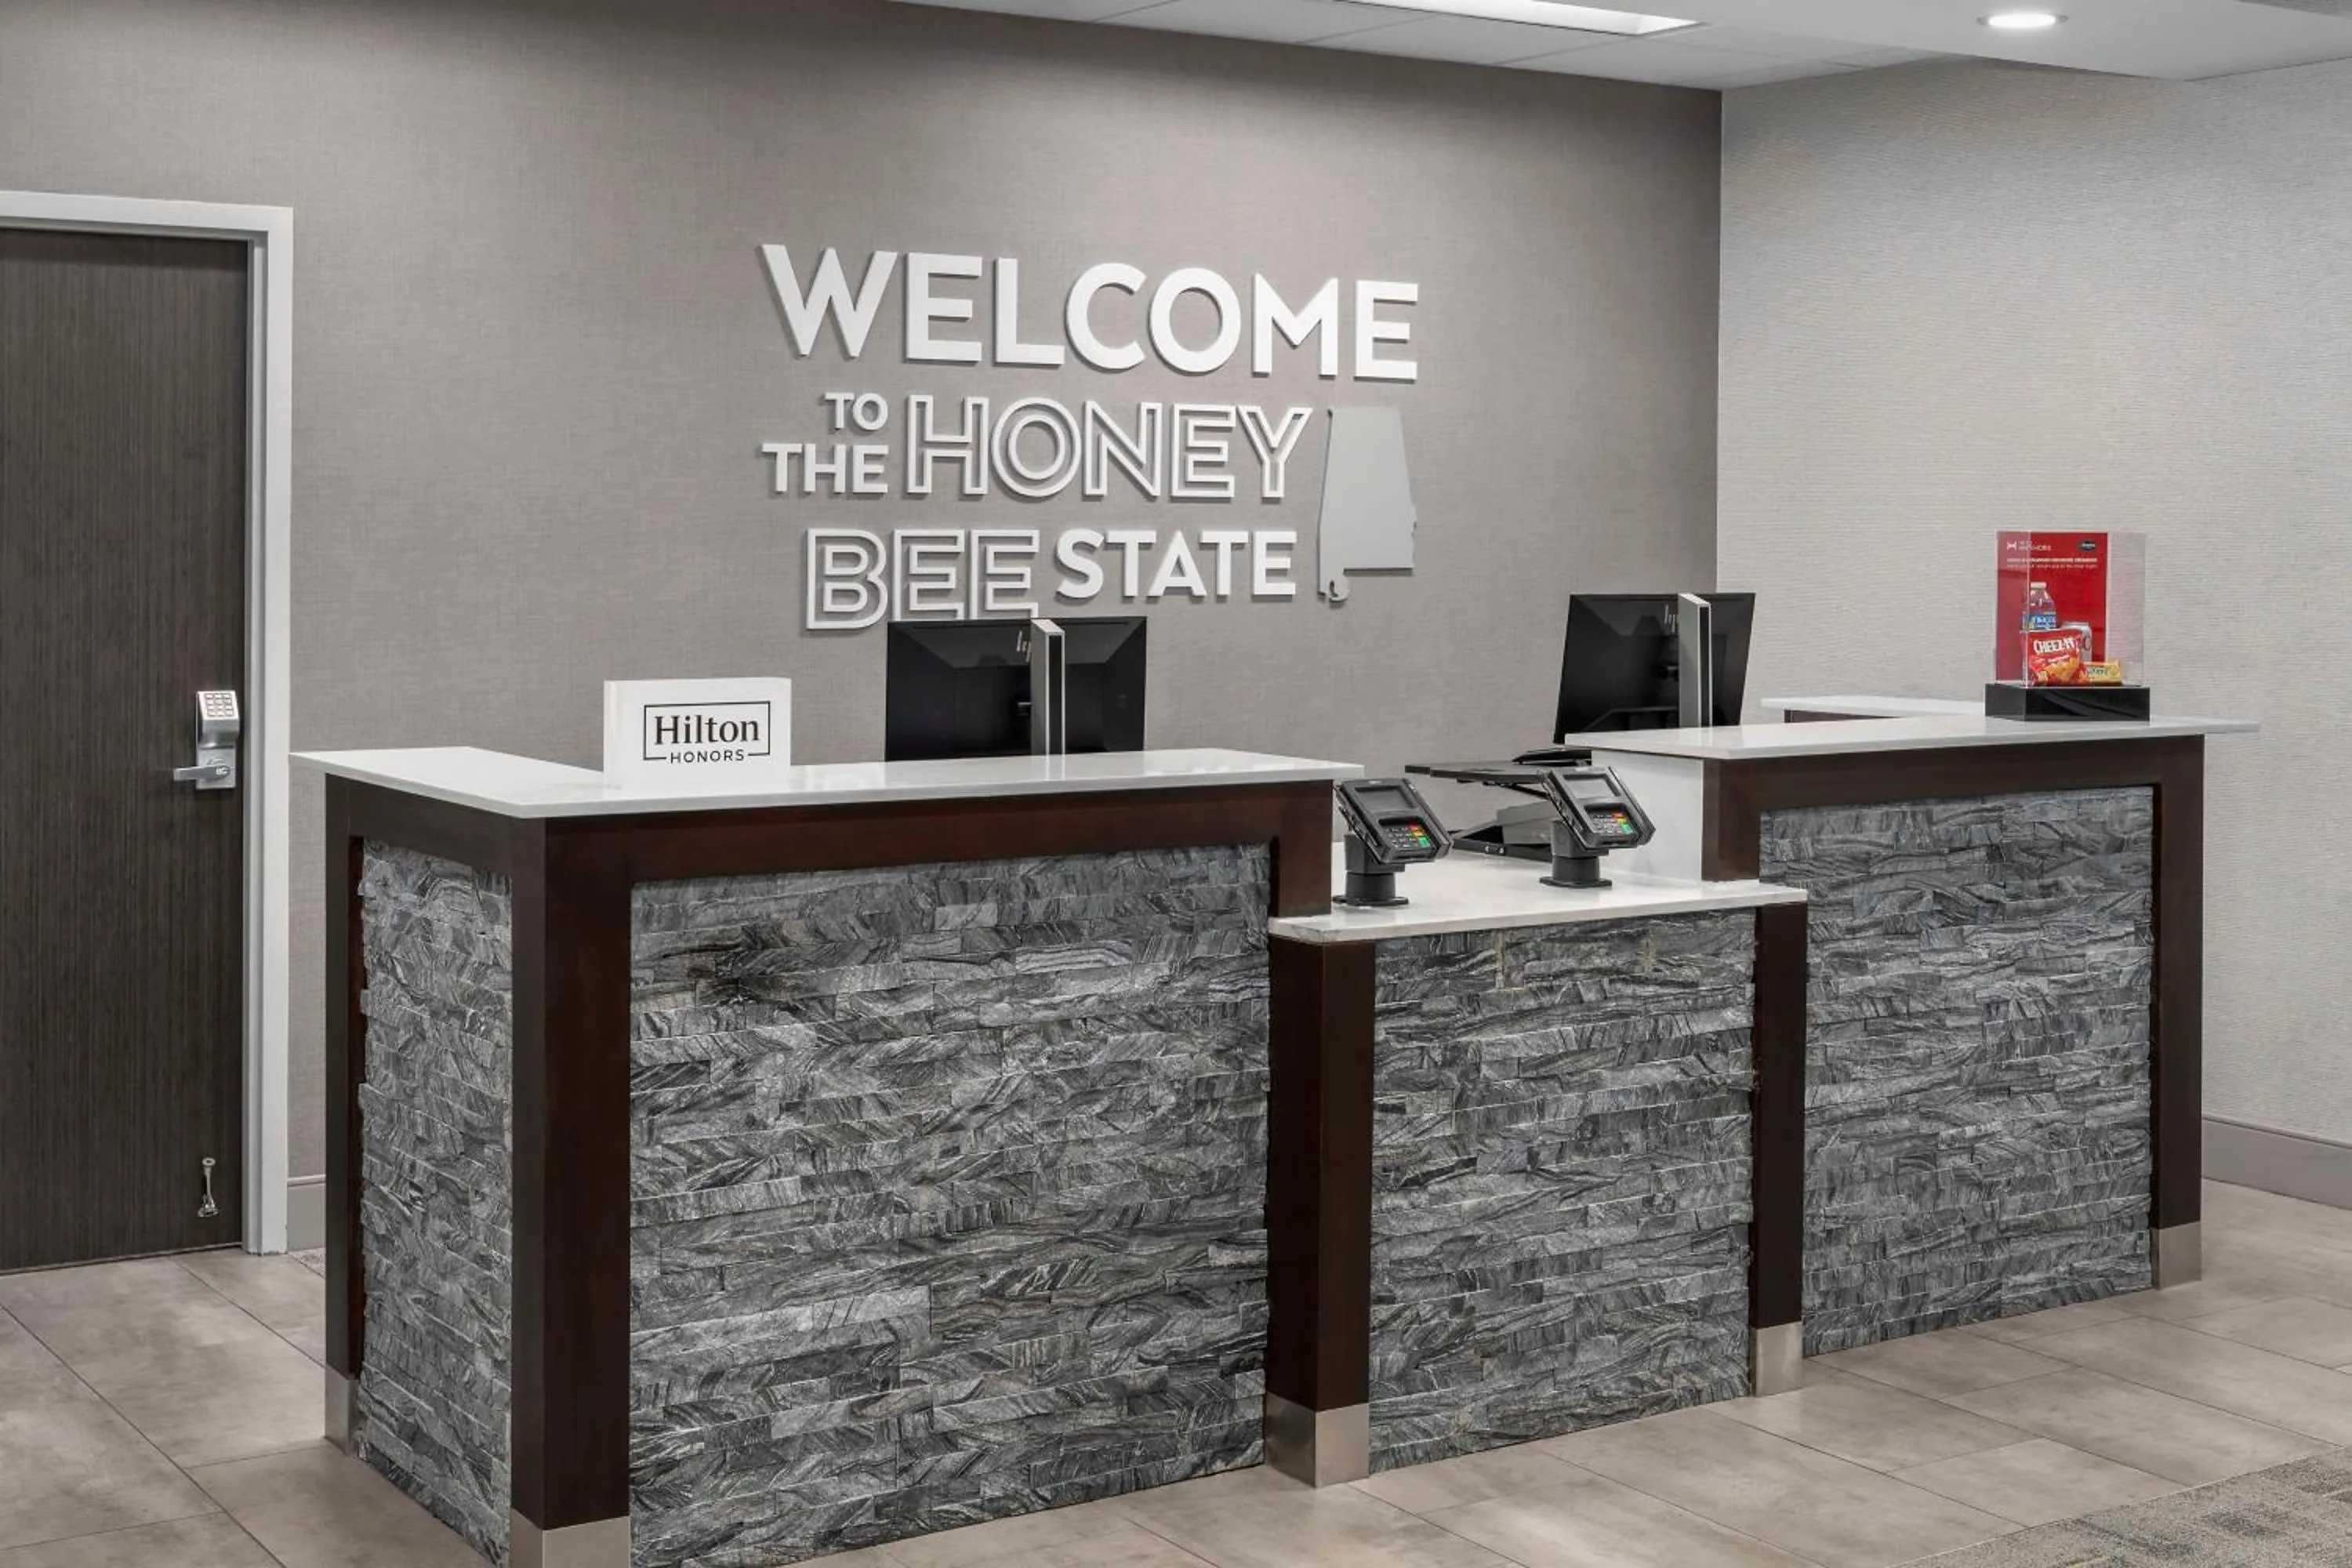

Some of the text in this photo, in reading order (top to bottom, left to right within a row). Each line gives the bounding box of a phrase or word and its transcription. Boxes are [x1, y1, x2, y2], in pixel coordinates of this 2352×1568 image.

[762, 245, 1418, 380] WELCOME
[826, 393, 888, 430] TO
[762, 394, 1313, 499] THE HONEY
[808, 528, 1298, 629] BEE STATE
[654, 715, 760, 745] Hilton
[670, 750, 745, 764] HONORS
